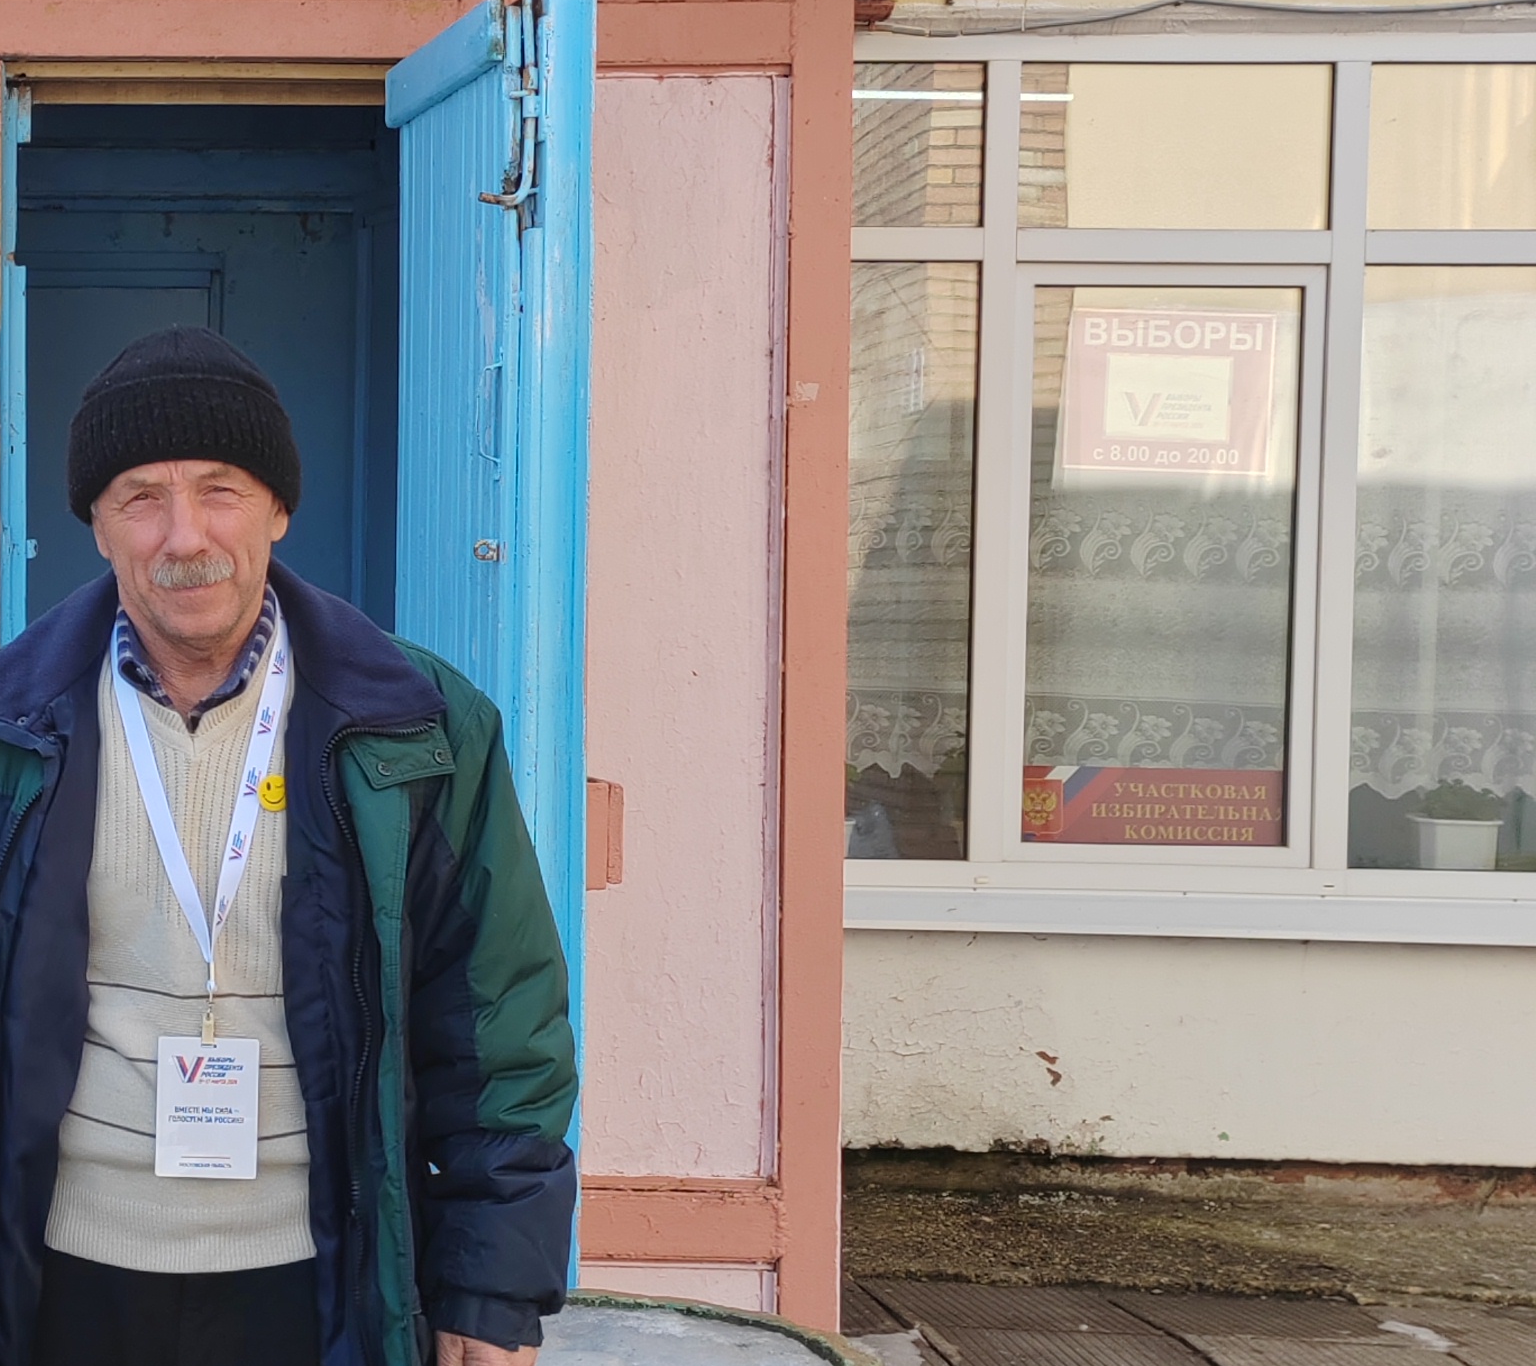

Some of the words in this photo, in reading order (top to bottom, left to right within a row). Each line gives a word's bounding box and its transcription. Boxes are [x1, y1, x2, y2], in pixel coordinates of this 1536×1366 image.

[1084, 316, 1263, 351] ВЫБОРЫ
[1110, 446, 1150, 462] 8.00
[1155, 449, 1181, 465] до
[1187, 447, 1239, 465] 20.00
[1114, 782, 1267, 800] УЧАСТКОВАЯ
[1124, 824, 1255, 842] КОМИССИЯ
